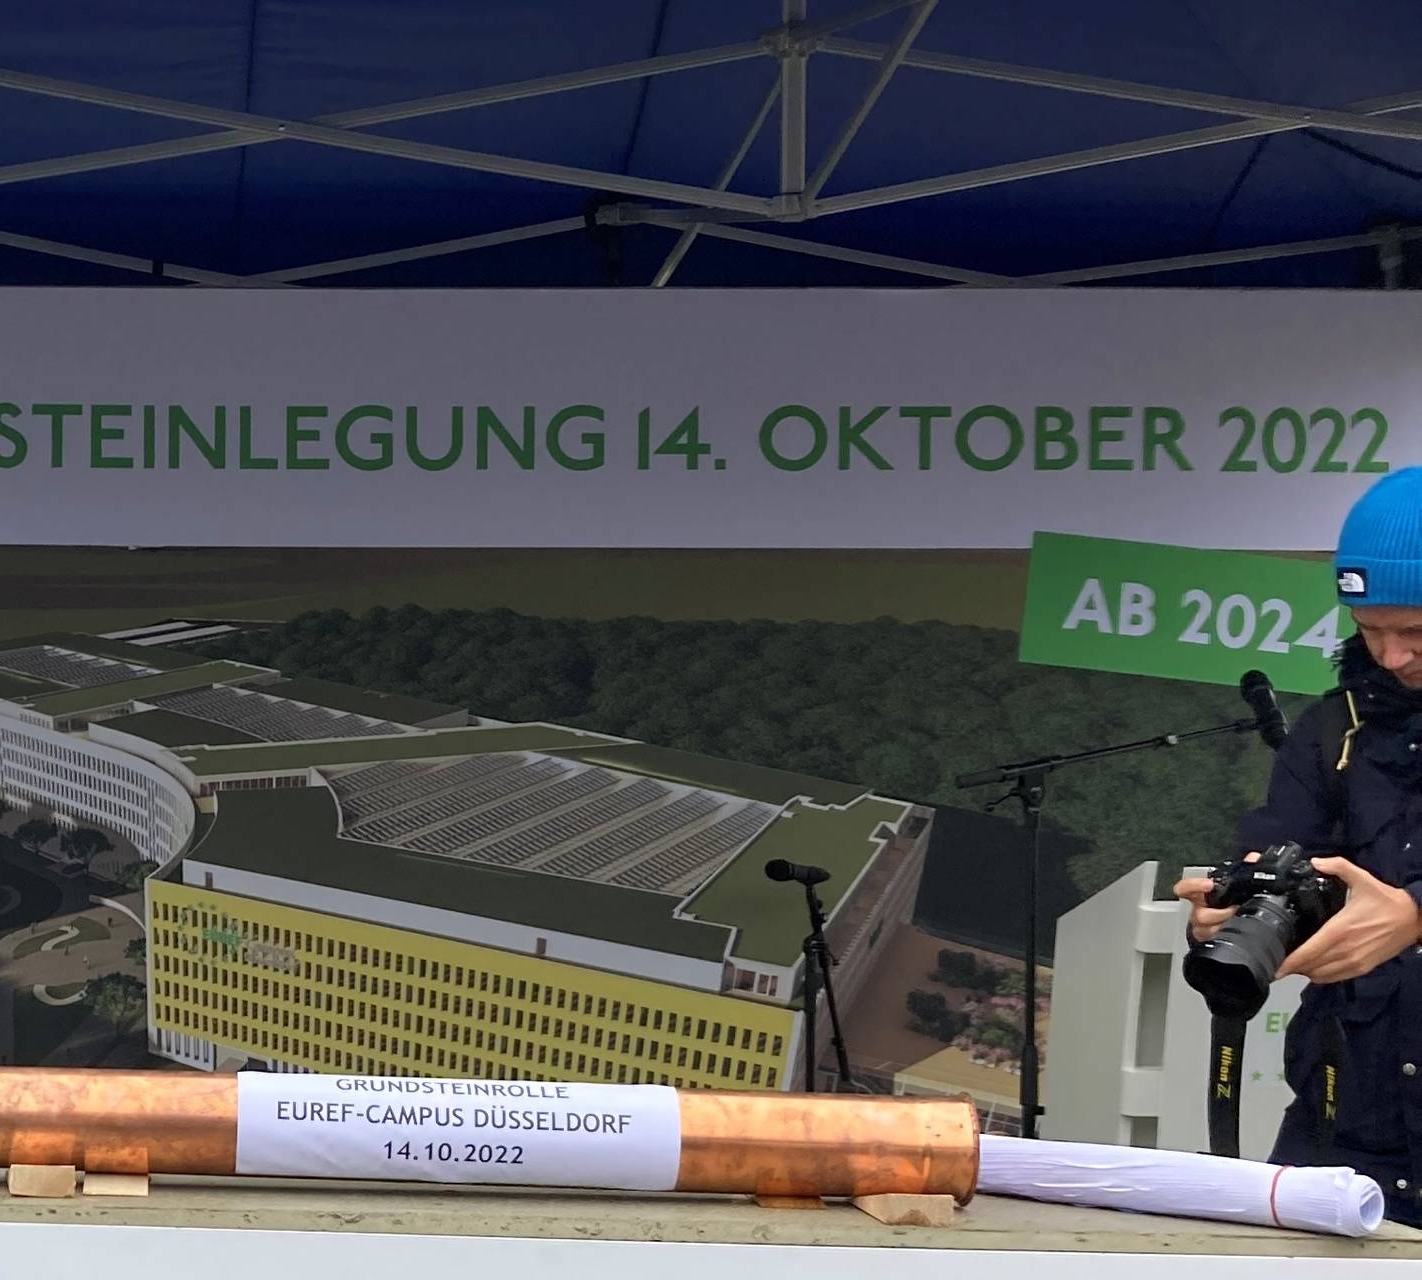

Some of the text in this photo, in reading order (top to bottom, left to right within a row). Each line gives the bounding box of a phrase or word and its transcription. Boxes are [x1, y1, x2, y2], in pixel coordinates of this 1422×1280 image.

[636, 405, 727, 471] 14.
[758, 404, 1195, 473] OKTOBER
[1218, 405, 1391, 474] 2022
[1062, 577, 1343, 660] AB 2024
[1220, 1046, 1232, 1081] Nikon
[335, 1077, 570, 1100] GRUNDSTEINROLLE
[277, 1101, 632, 1134] EUREF-CAMPUS DÜSSELDORF
[383, 1141, 525, 1165] 14.10.2022
